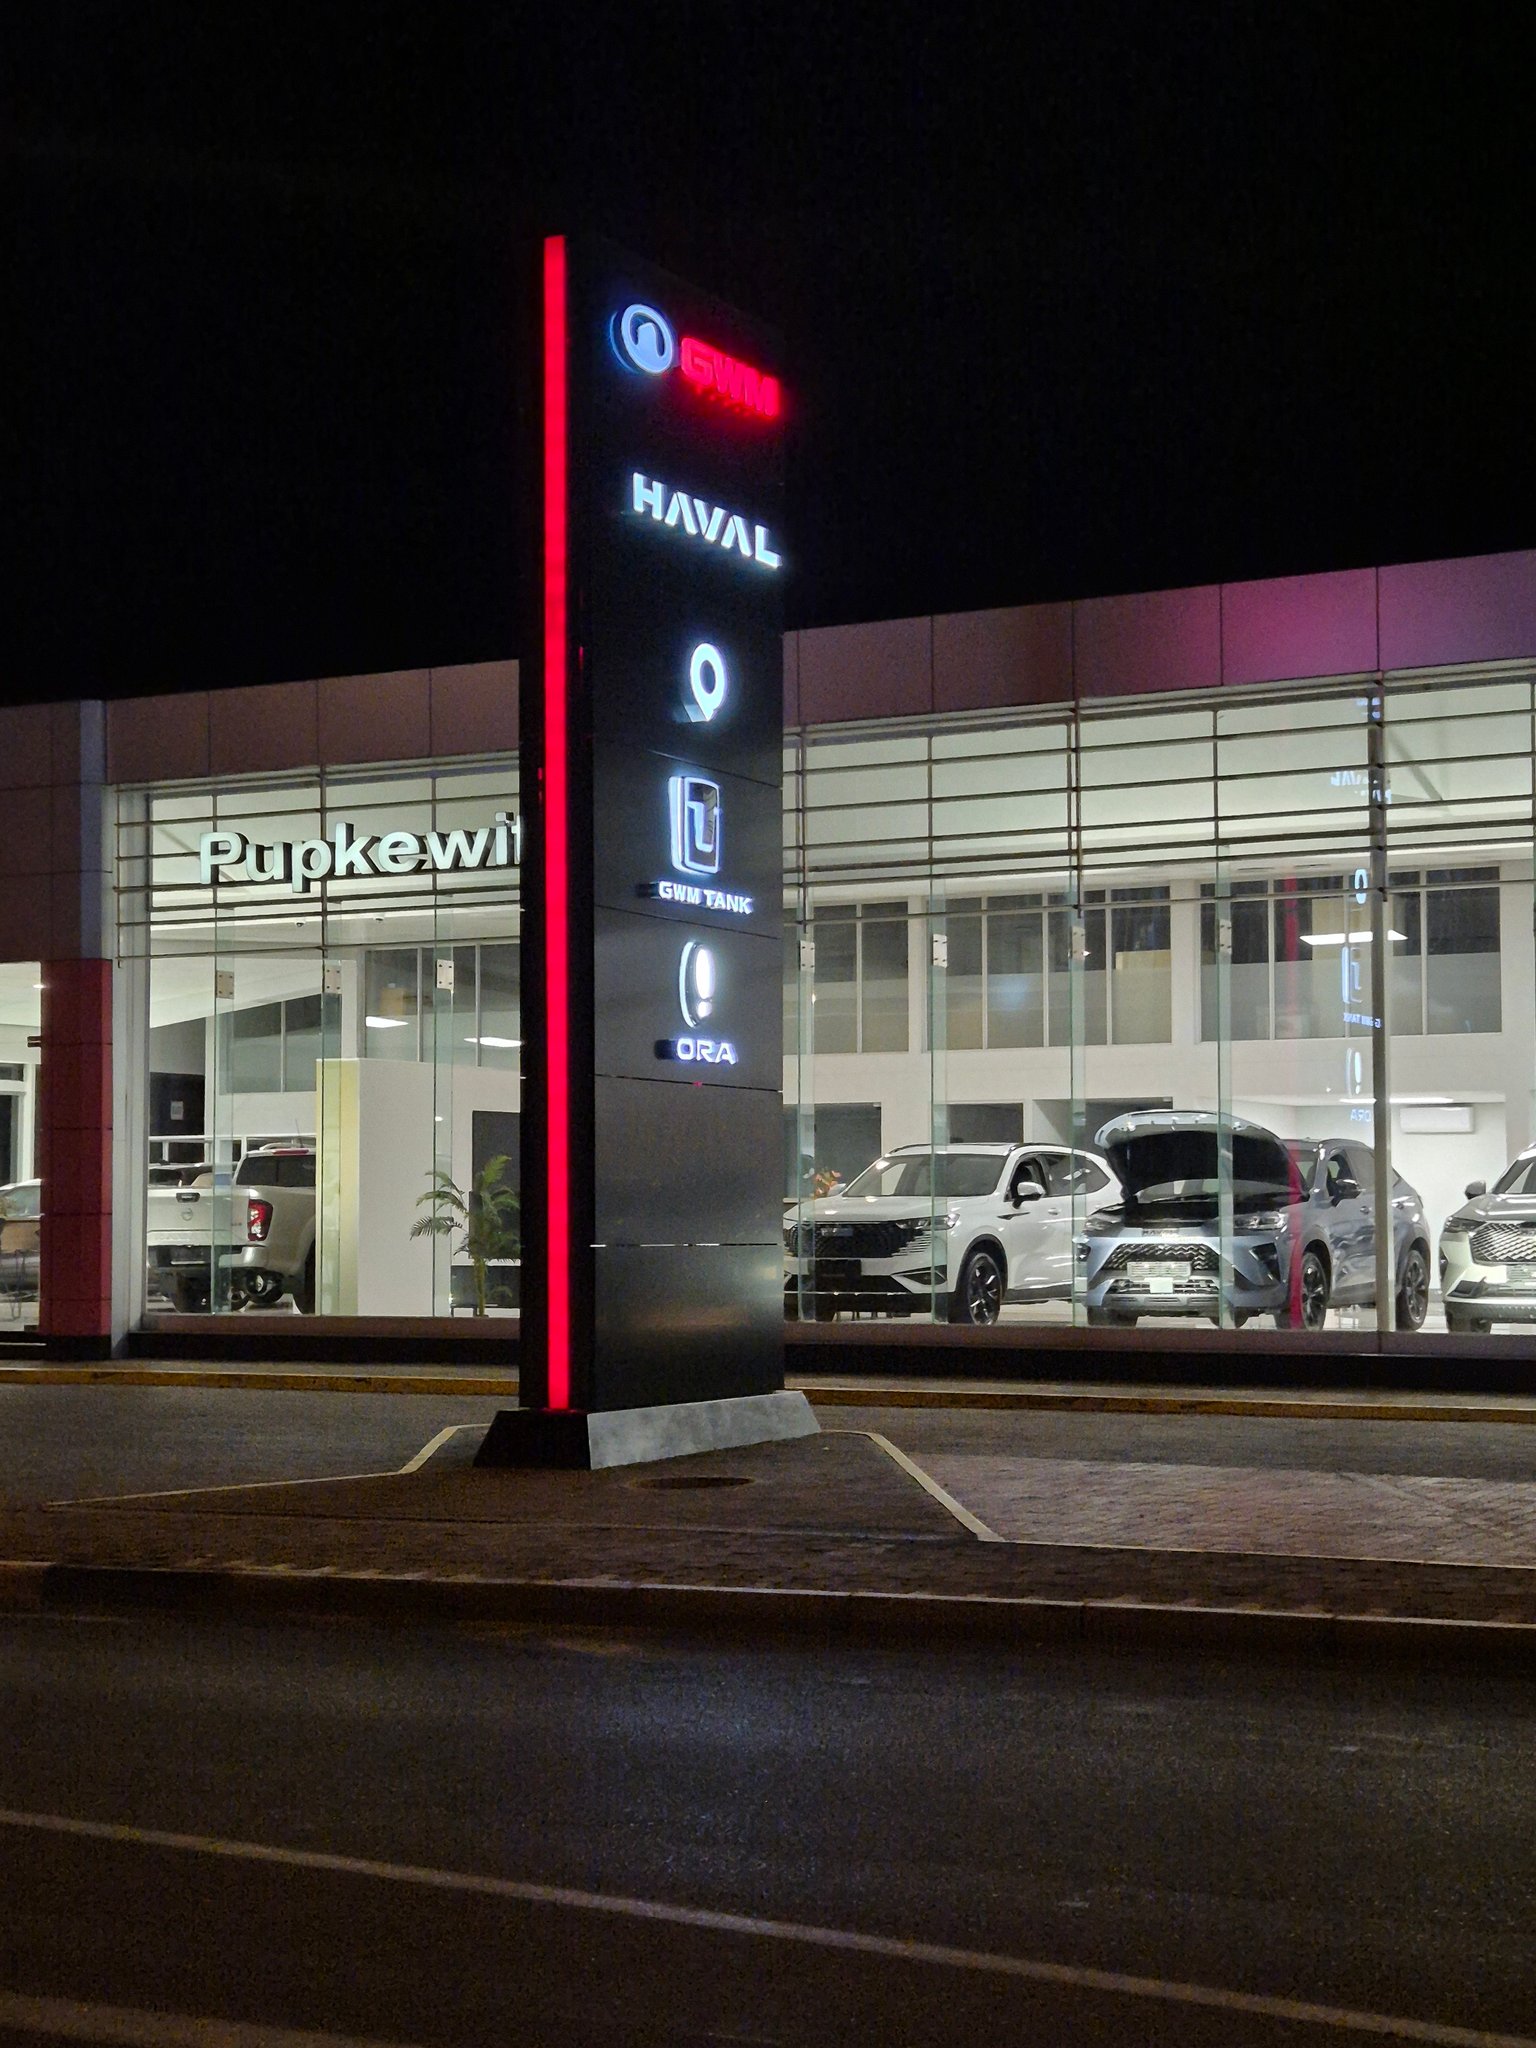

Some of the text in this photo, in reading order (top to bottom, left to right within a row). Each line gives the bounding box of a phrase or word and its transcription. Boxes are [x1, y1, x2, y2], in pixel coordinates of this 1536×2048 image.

[680, 336, 780, 417] GWM
[631, 472, 782, 568] HAVAL
[658, 880, 753, 914] GWM TANK
[676, 1037, 738, 1065] ORA
